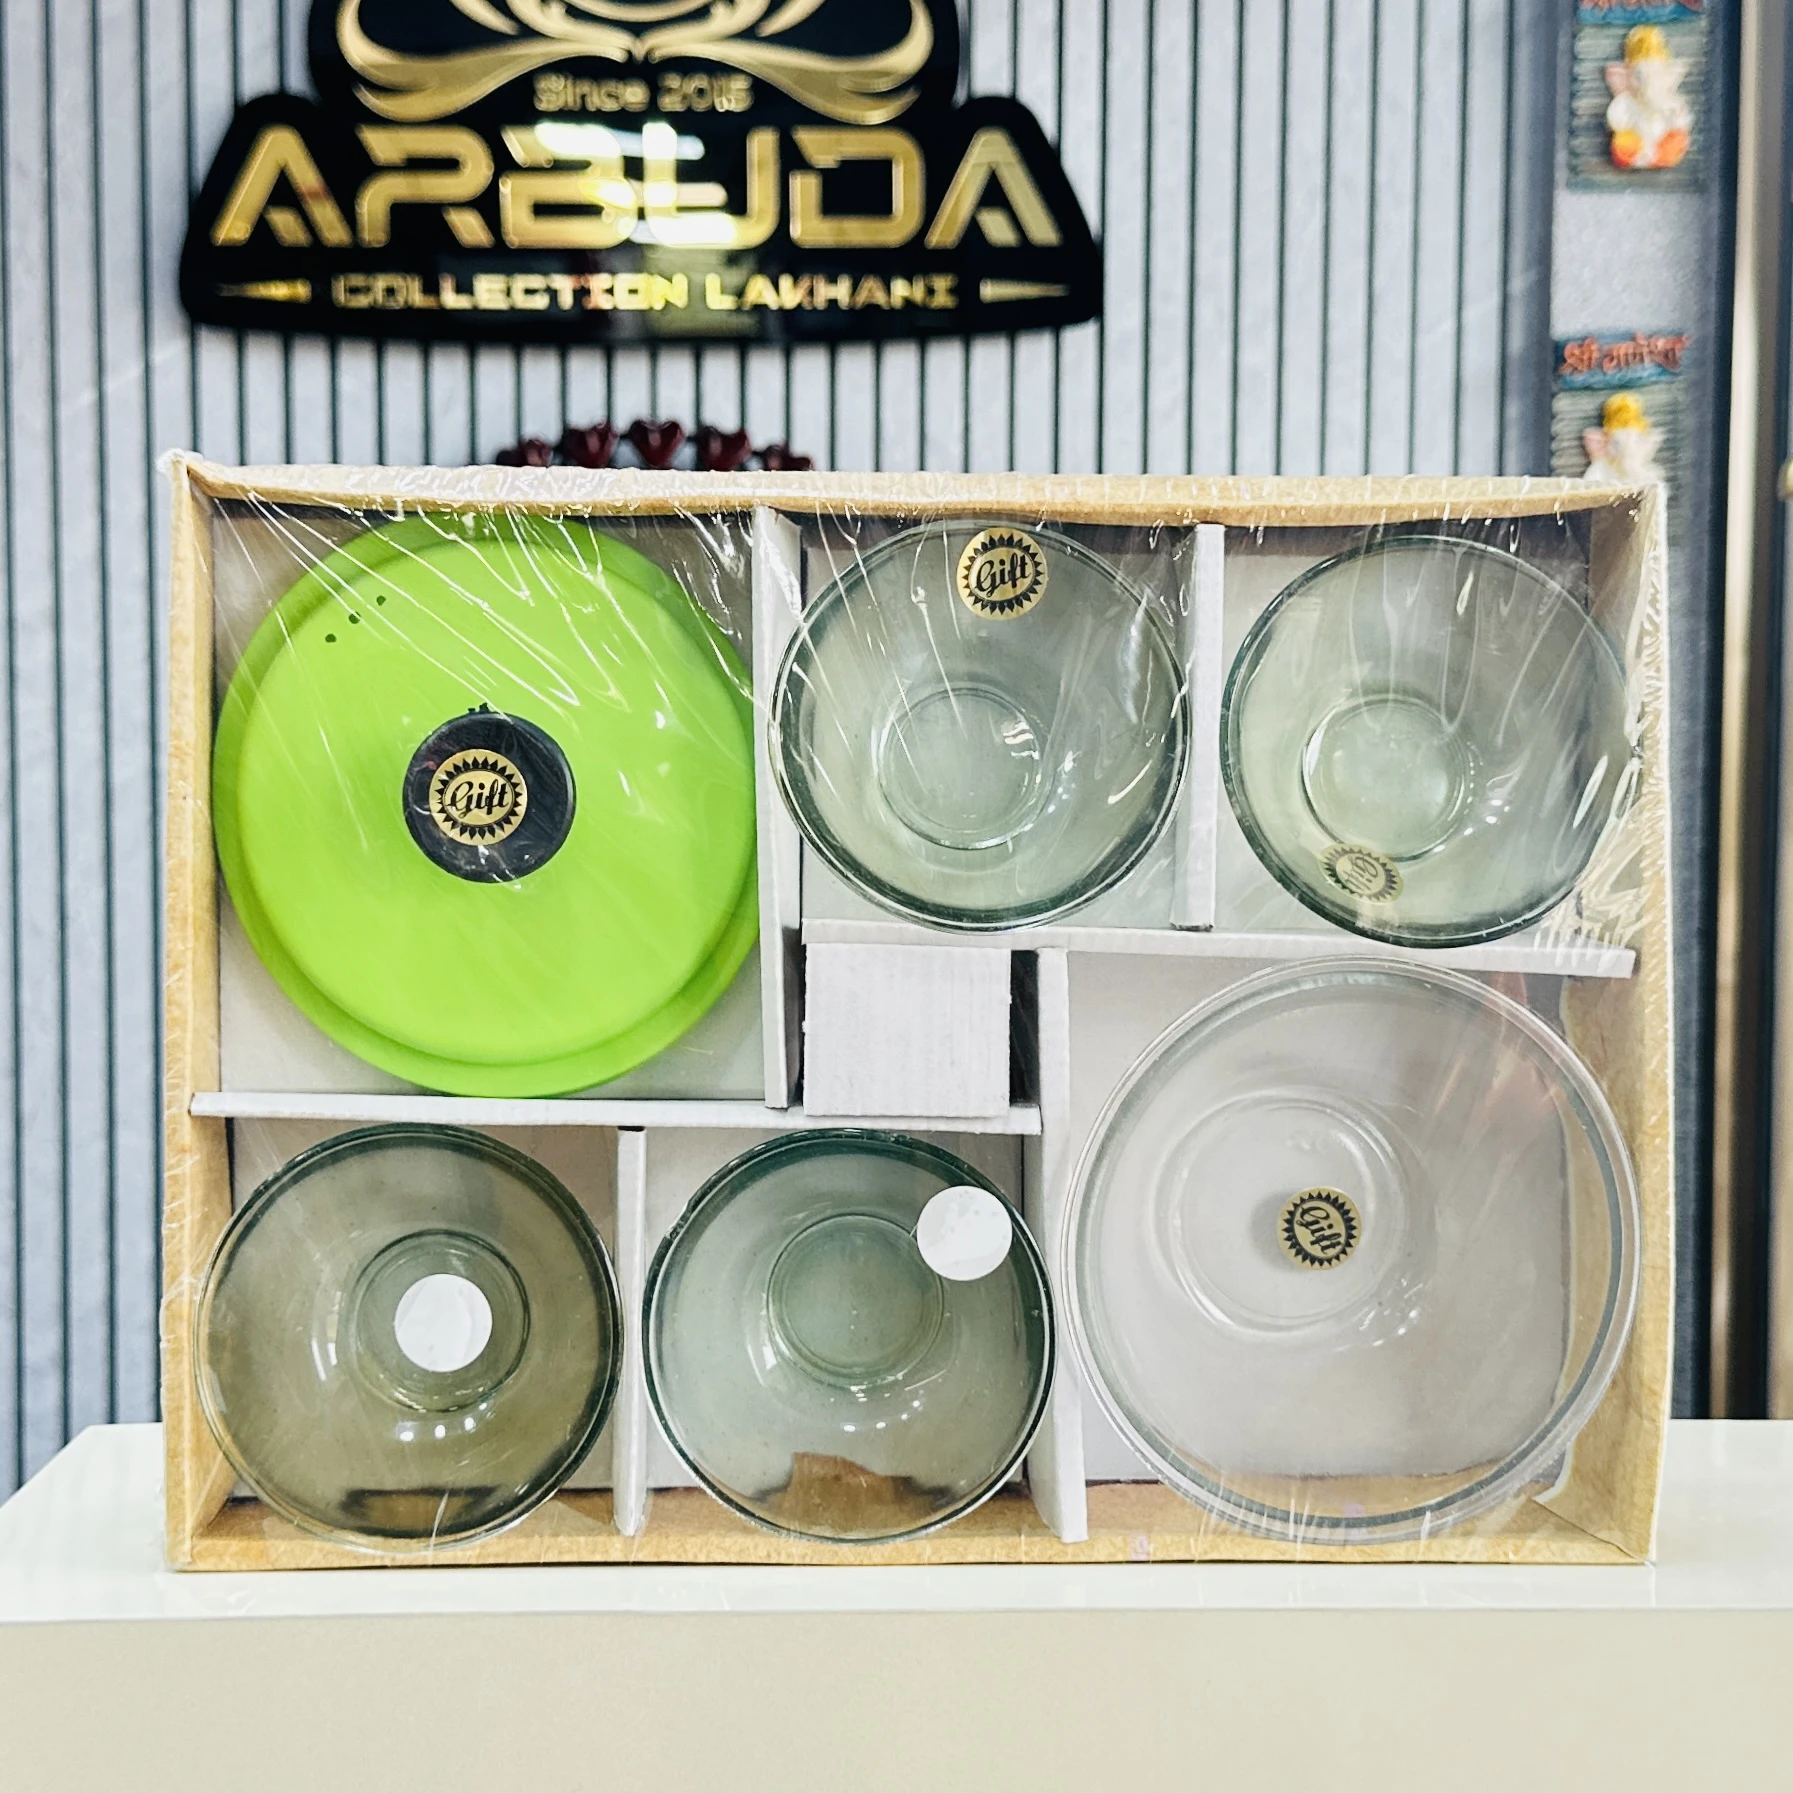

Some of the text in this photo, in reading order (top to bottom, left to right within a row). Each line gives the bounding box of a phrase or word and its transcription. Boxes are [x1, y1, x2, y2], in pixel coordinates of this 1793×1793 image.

[534, 72, 650, 112] Since
[210, 124, 1063, 249] ARBUDA
[331, 273, 959, 309] COLLECTION LAKHANI
[975, 552, 1032, 598] Gift
[447, 779, 510, 820] Gift
[1296, 1206, 1342, 1254] Gift
